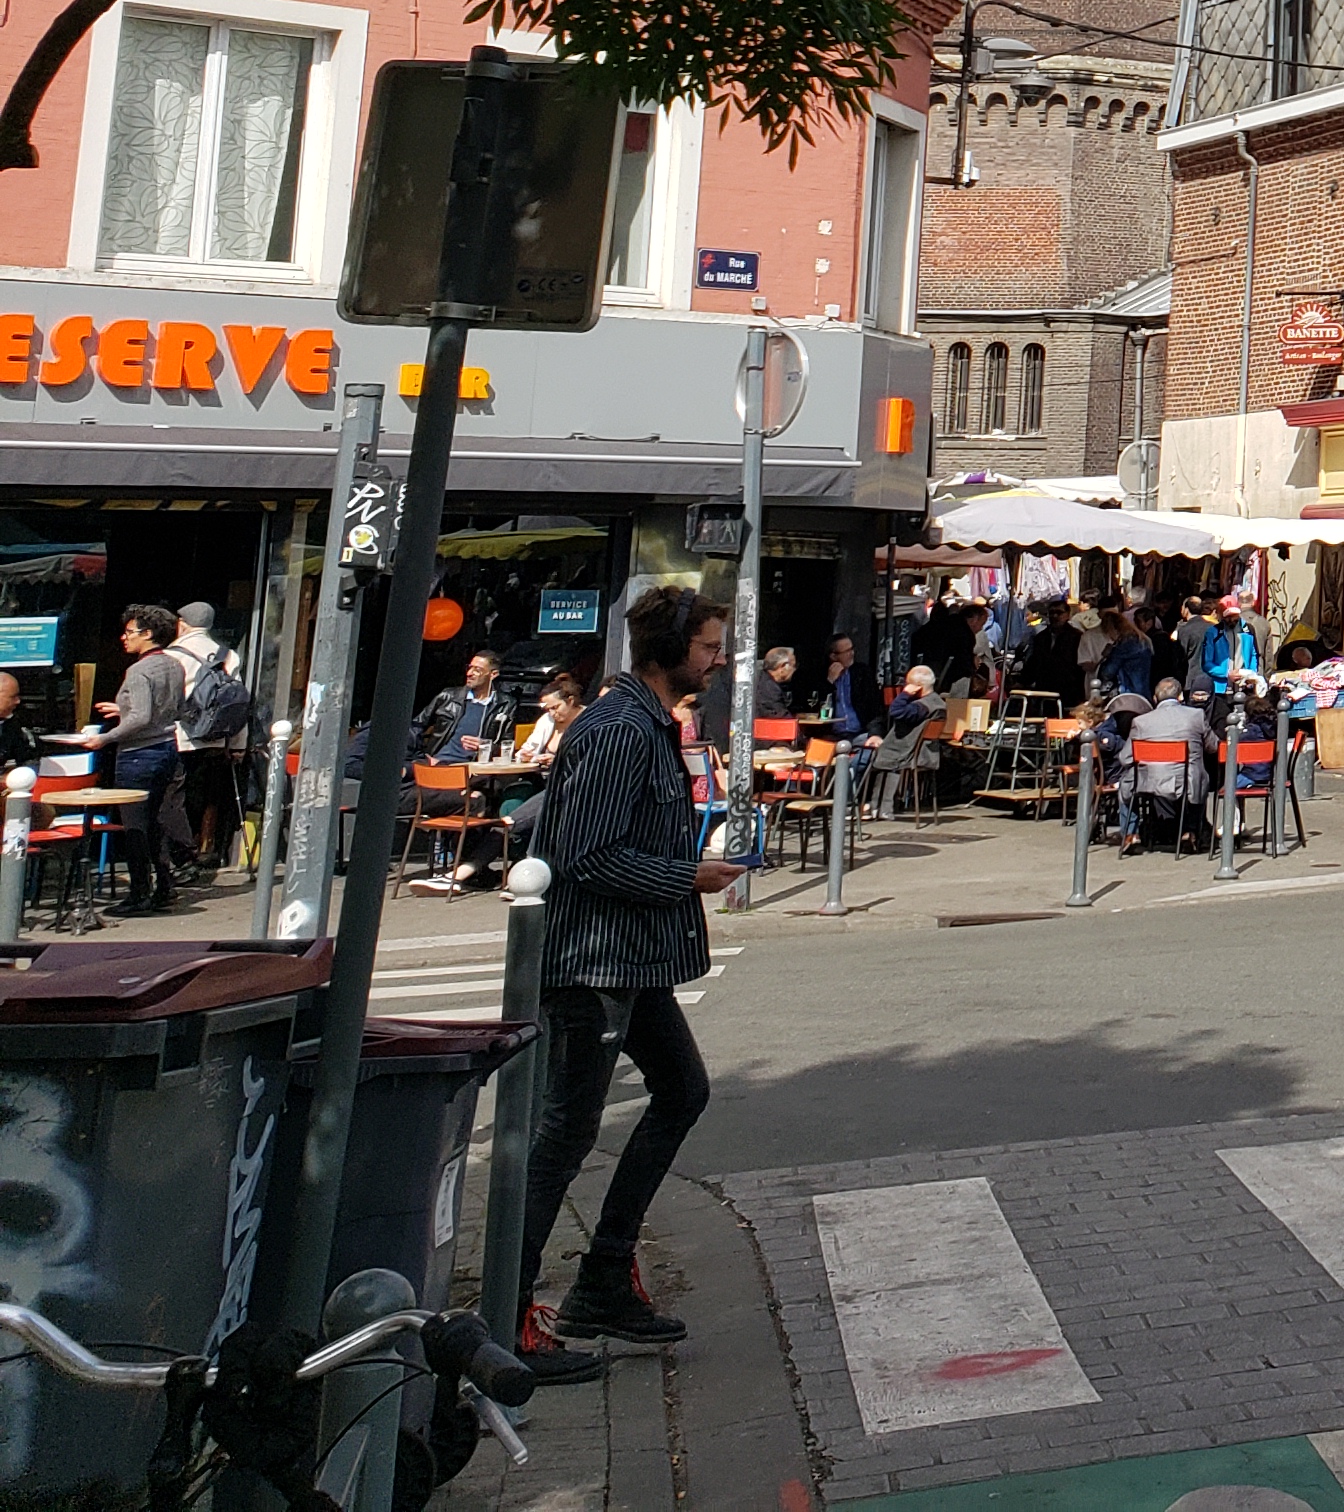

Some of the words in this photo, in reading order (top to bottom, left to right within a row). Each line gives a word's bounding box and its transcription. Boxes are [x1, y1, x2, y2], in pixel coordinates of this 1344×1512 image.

[729, 257, 746, 269] Rue
[704, 271, 715, 282] du
[716, 272, 753, 285] MARCHÉ
[1286, 328, 1340, 339] BANETTE
[398, 364, 490, 399] BR
[550, 600, 588, 609] SERVICE
[552, 611, 565, 620] AU
[565, 611, 584, 620] BAR
